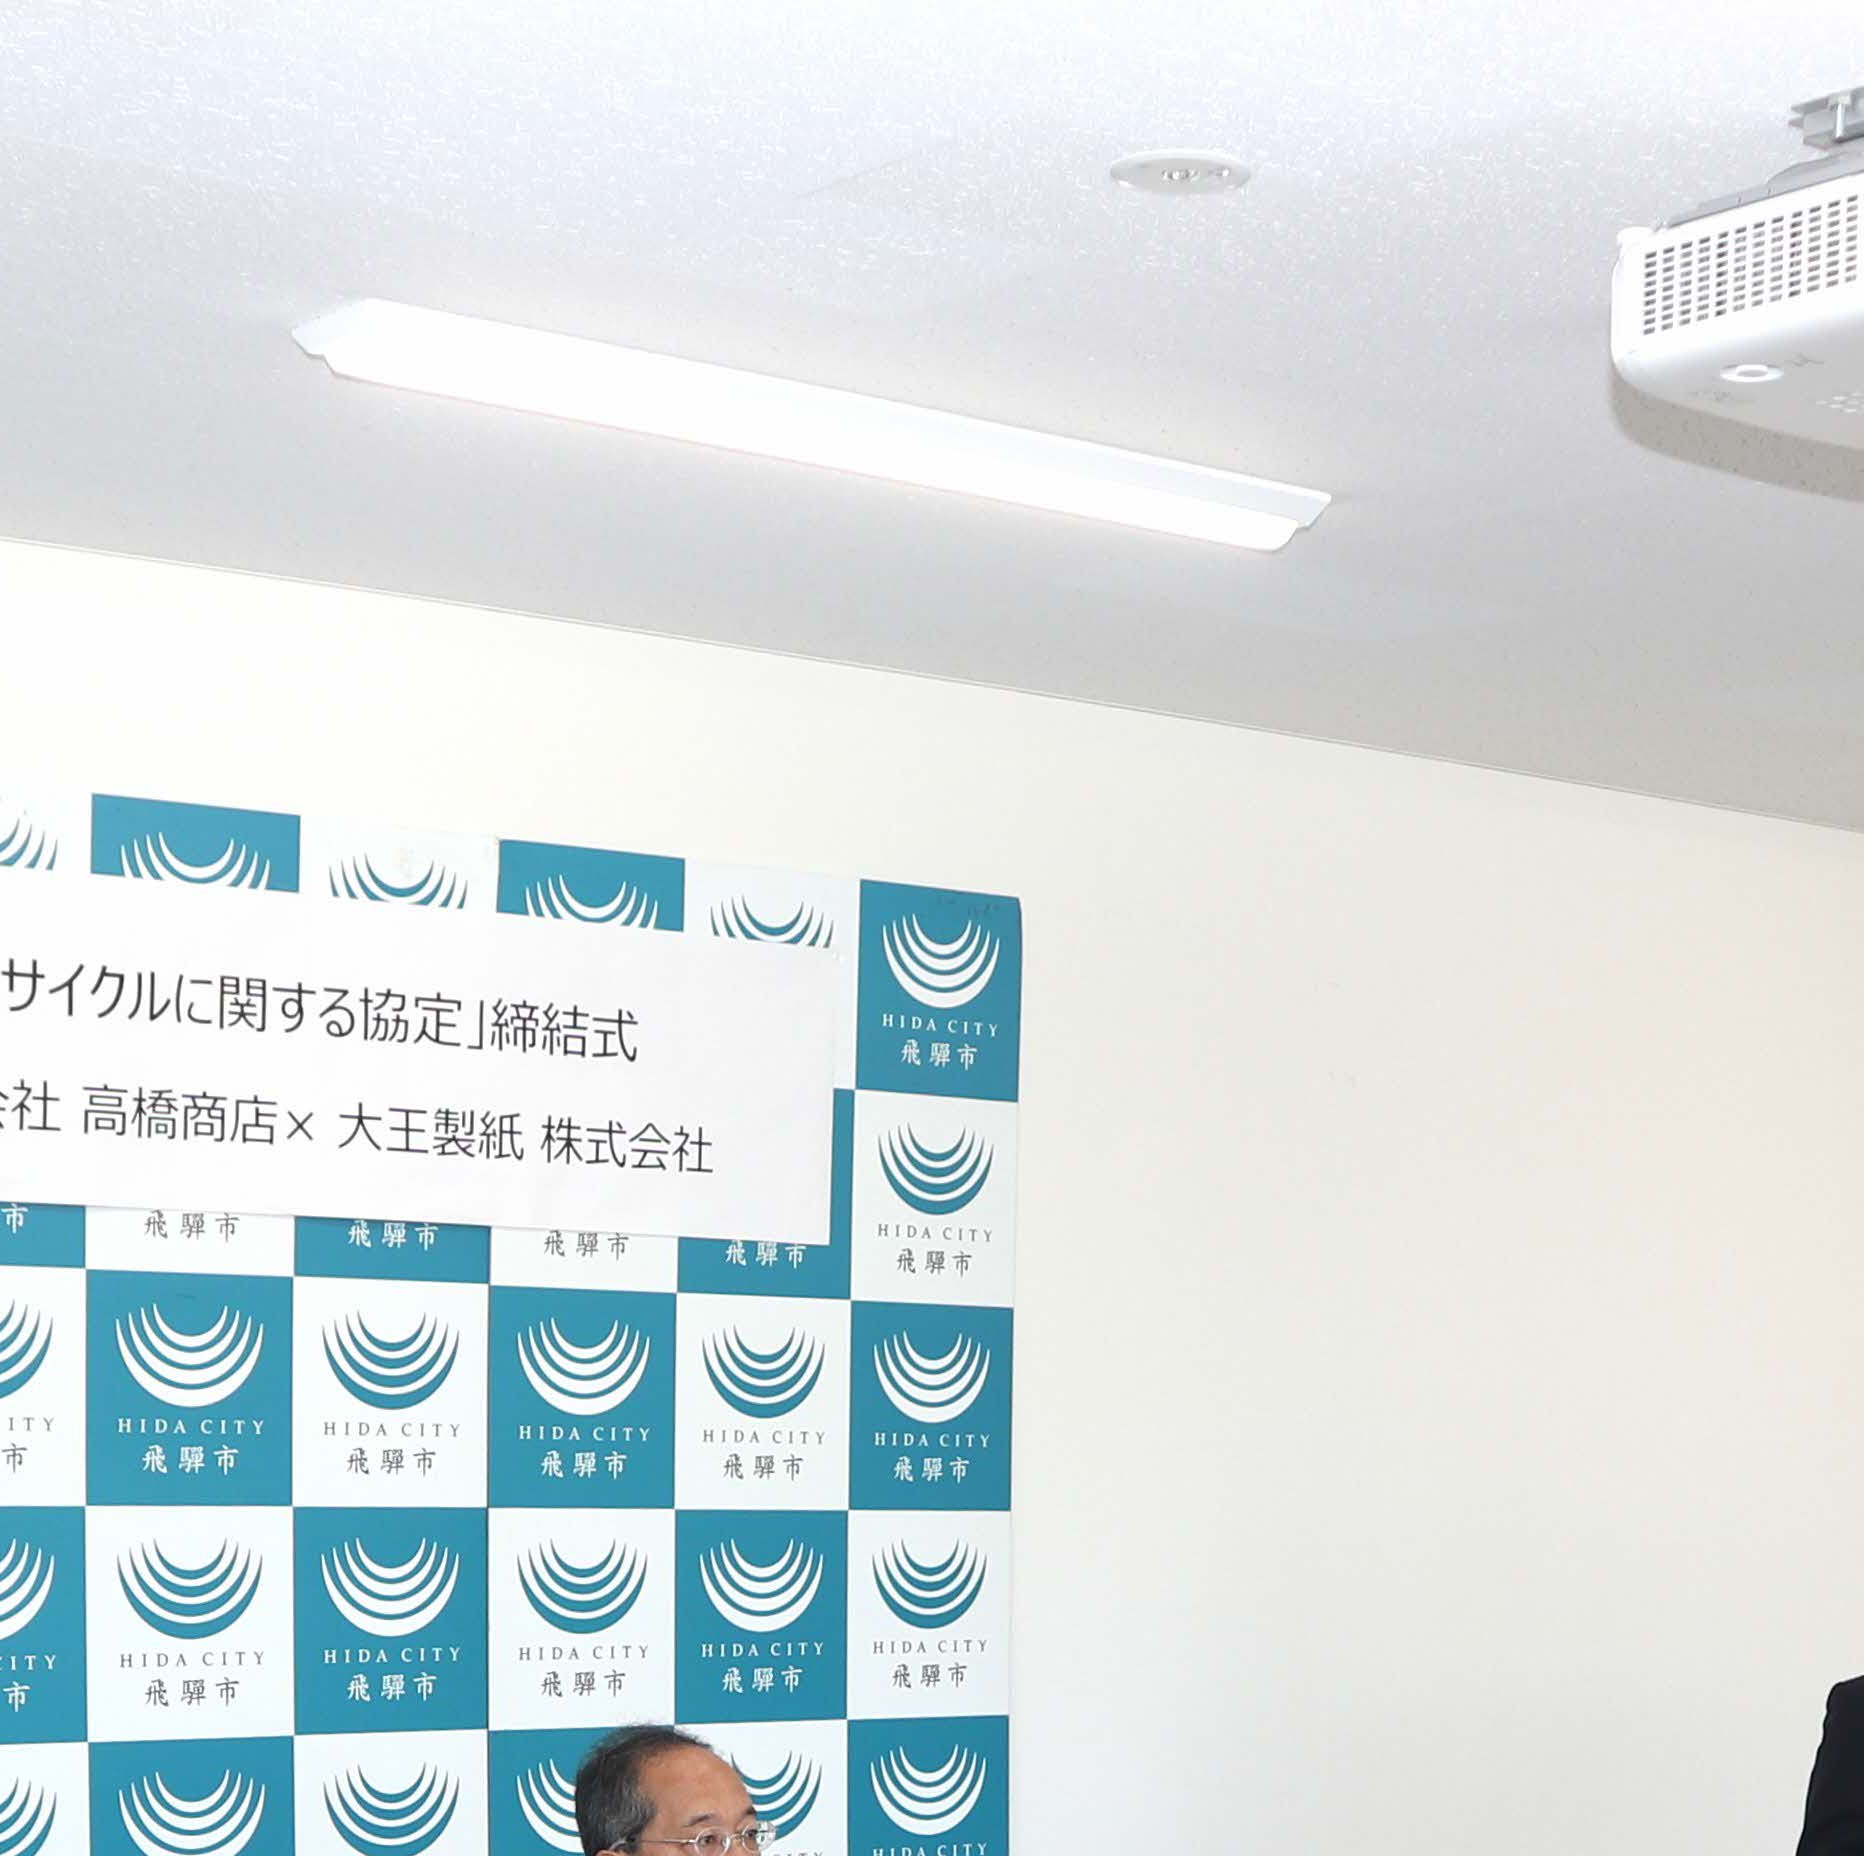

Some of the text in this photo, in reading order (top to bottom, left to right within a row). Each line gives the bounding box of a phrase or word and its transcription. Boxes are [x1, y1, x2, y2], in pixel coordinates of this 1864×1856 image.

[882, 1013, 998, 1038] HIDA CITY
[337, 1100, 524, 1162] 大王製紙
[539, 1113, 715, 1174] 株式会社
[877, 1223, 992, 1243] HIDA CITY
[117, 1417, 265, 1435] HIDA CITY
[518, 1424, 650, 1442] HIDA CITY
[702, 1428, 825, 1446] HIDA CITY
[874, 1431, 990, 1449] HIDA CITY
[323, 1646, 461, 1665] HIDA CITY
[518, 1644, 649, 1662] HIDA CITY
[872, 1638, 987, 1655] HIDA CITY
